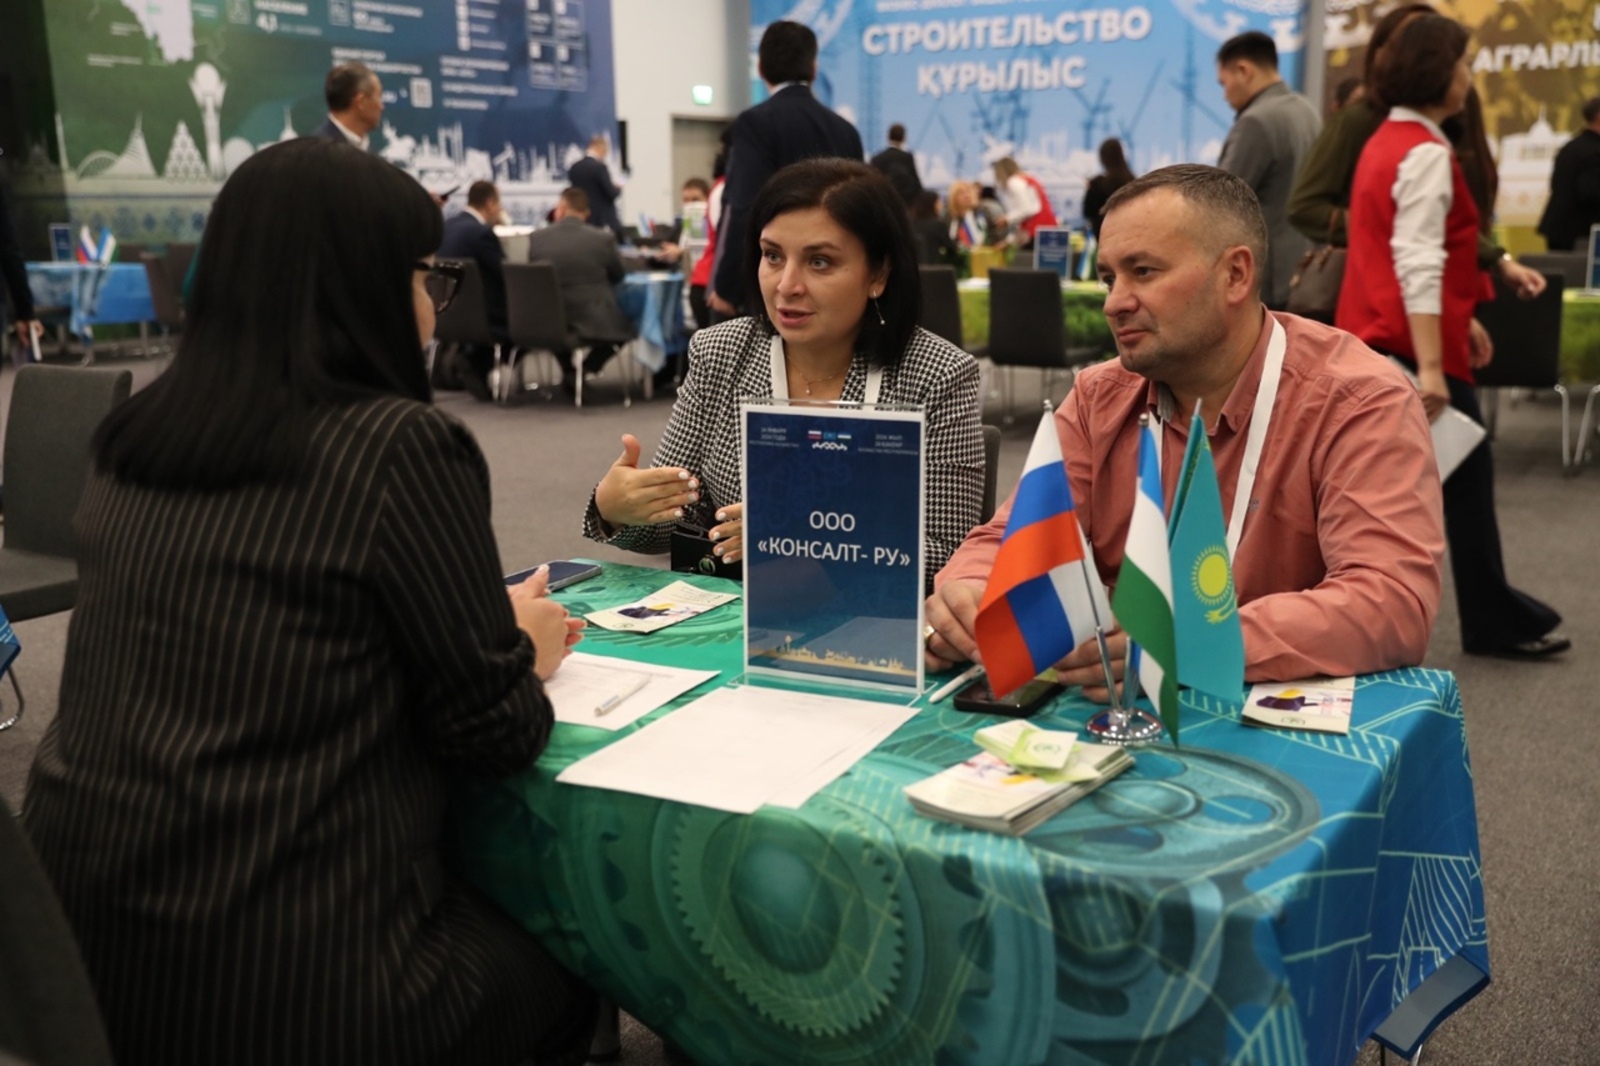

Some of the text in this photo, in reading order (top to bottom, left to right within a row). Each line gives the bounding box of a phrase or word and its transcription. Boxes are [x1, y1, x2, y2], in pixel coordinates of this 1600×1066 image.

[862, 6, 1153, 56] СТРОИТЕЛЬСТВО
[917, 56, 1087, 99] ҚҰРЫЛЫС
[809, 511, 856, 532] ООО
[873, 547, 911, 566] РУ»
